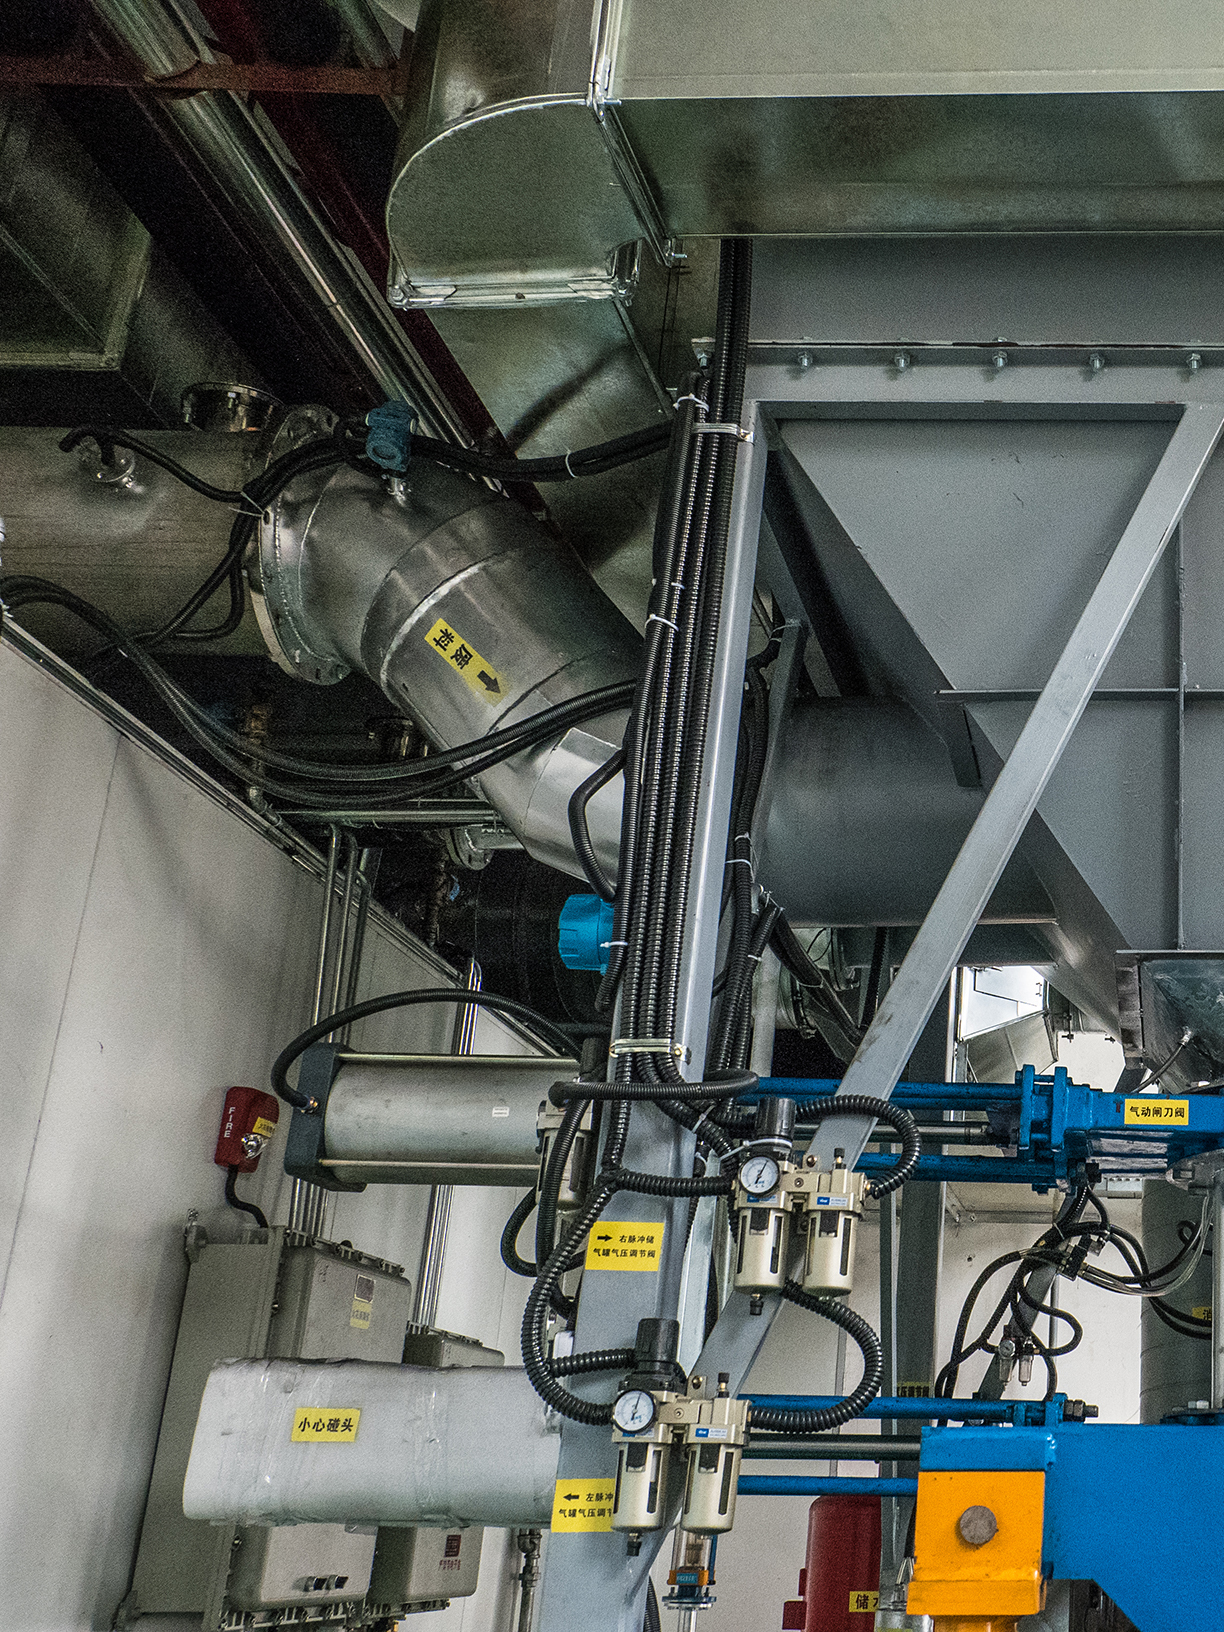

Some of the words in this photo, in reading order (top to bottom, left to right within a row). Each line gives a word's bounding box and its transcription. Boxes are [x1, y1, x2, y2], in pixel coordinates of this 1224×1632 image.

[1129, 1105, 1185, 1118] 气动闸刀阀
[223, 1106, 236, 1138] FIRE
[618, 1234, 655, 1244] 右脉冲储
[592, 1247, 657, 1258] 气罐气压调节阀
[298, 1417, 354, 1433] 小心碰头
